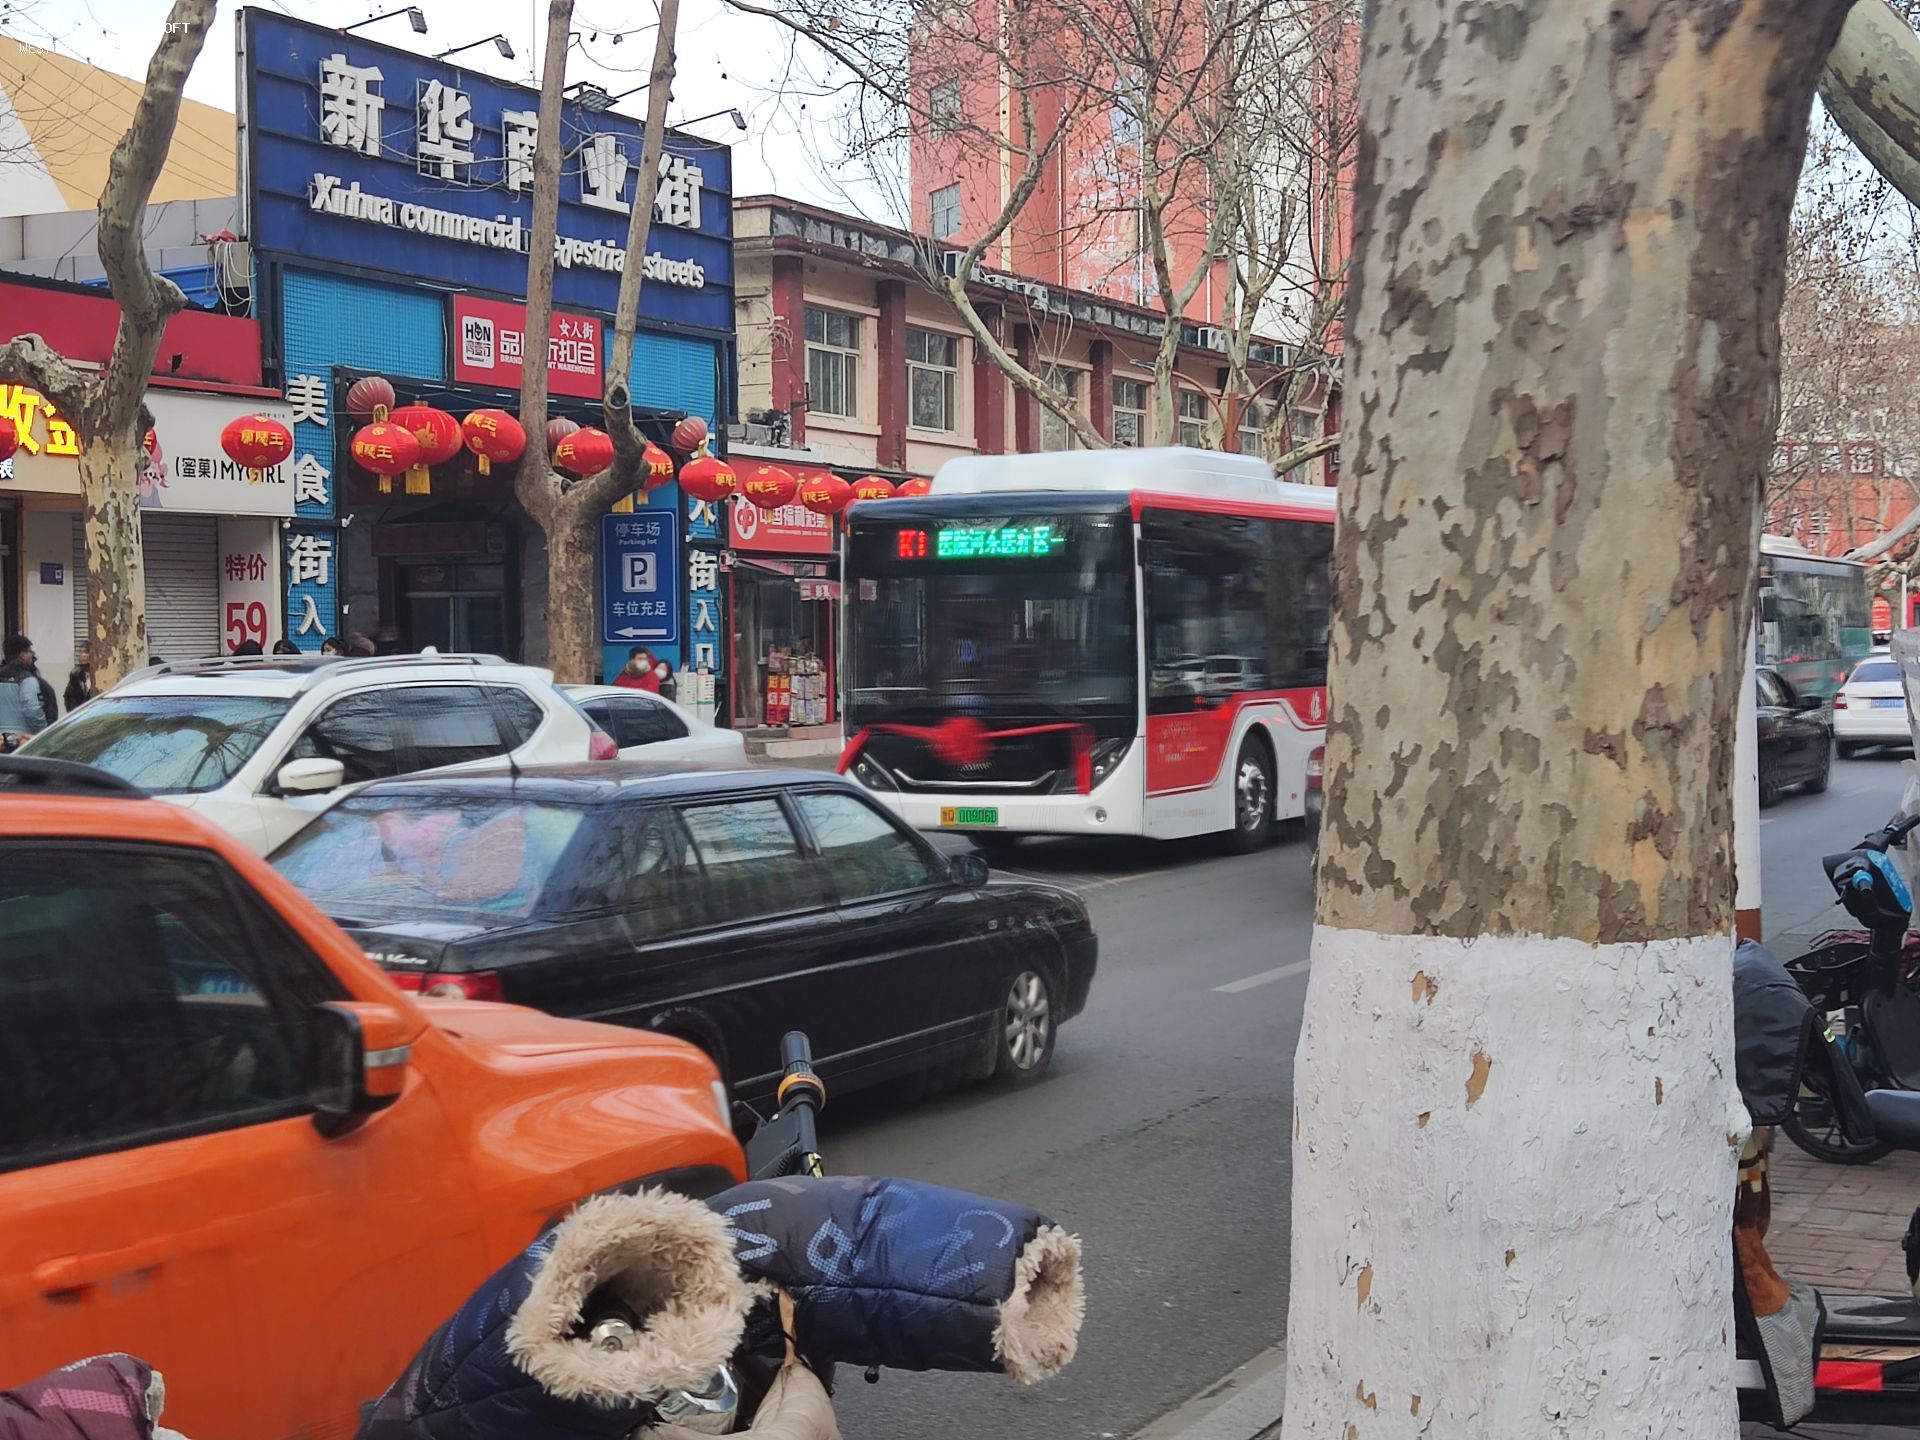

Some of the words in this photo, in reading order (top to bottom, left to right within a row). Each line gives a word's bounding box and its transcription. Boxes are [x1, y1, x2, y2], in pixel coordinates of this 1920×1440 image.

[319, 53, 703, 230] 新华商业街
[310, 173, 395, 225] Xinhua
[399, 202, 522, 251] commercial
[559, 318, 594, 341] 女人街
[499, 330, 596, 367] 品折扣仓
[286, 374, 333, 636] 美食街入
[615, 521, 661, 537] 停车场
[618, 538, 645, 547] Parking
[646, 538, 657, 546] lot
[225, 553, 268, 582] 特价
[612, 600, 667, 617] 车位充足
[225, 601, 268, 654] 59
